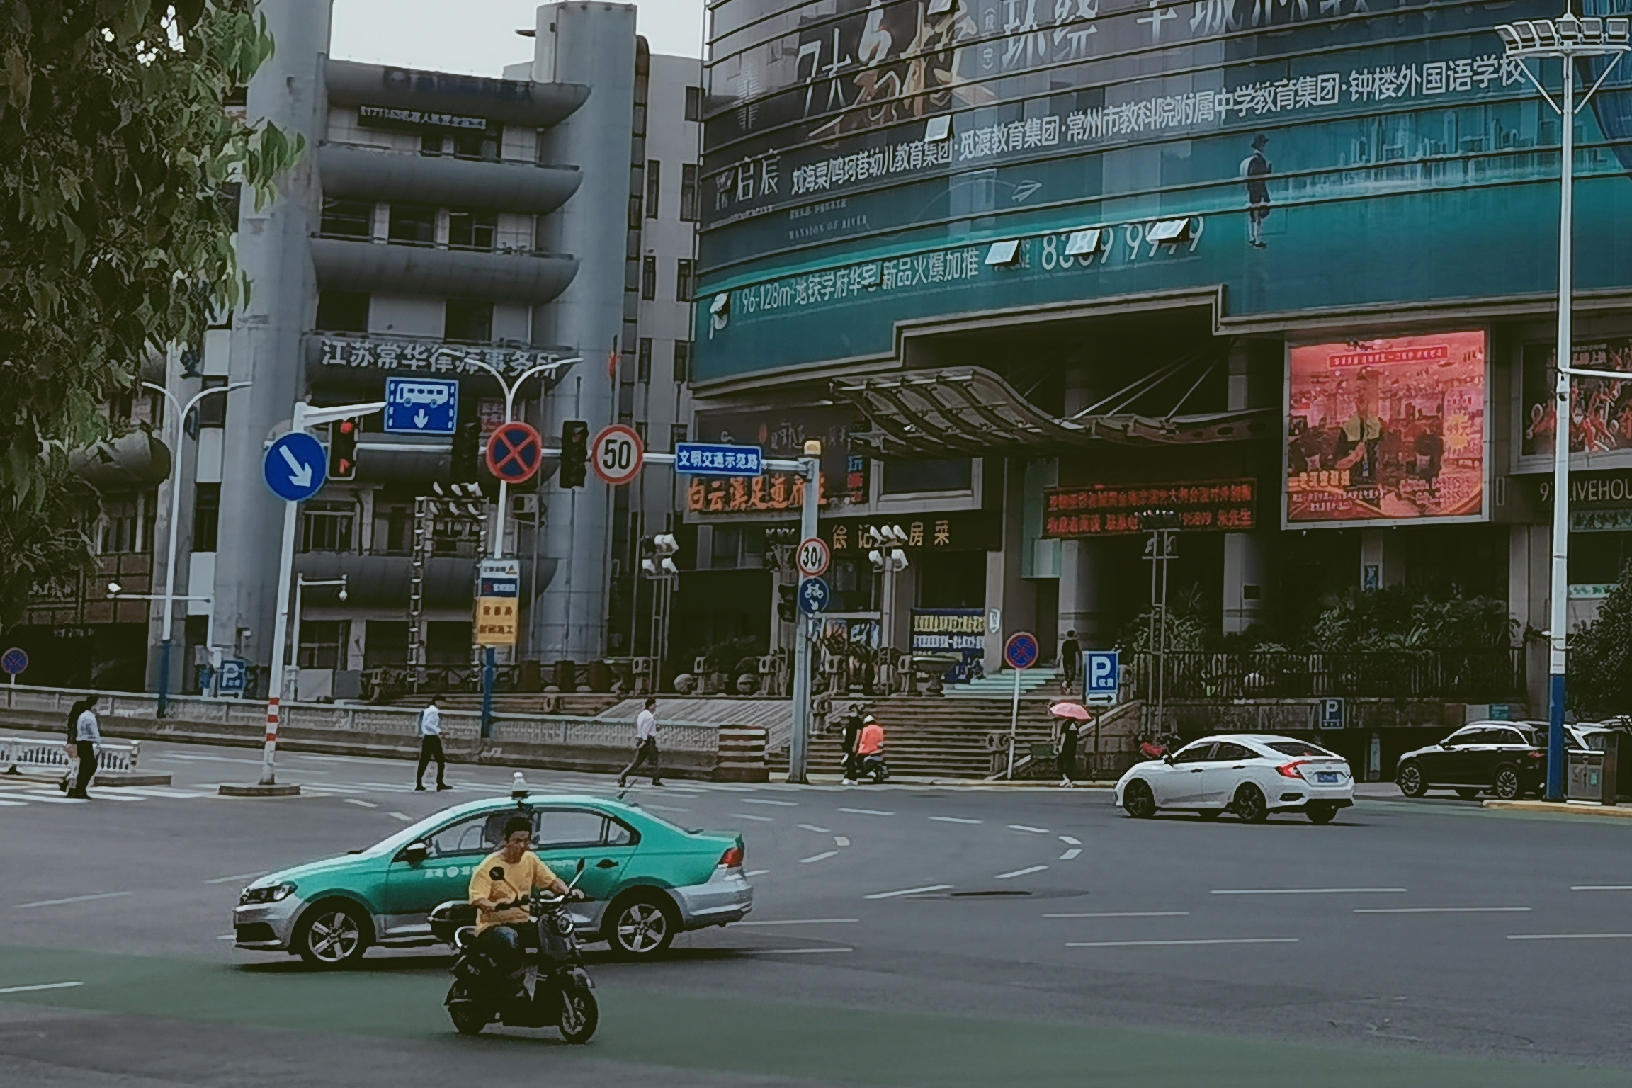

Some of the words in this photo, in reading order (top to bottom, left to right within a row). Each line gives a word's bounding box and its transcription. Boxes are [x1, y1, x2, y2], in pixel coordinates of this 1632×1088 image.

[602, 438, 632, 472] 50
[678, 449, 758, 470] 文明交通示范路
[803, 549, 821, 568] 30
[1091, 656, 1112, 688] P
